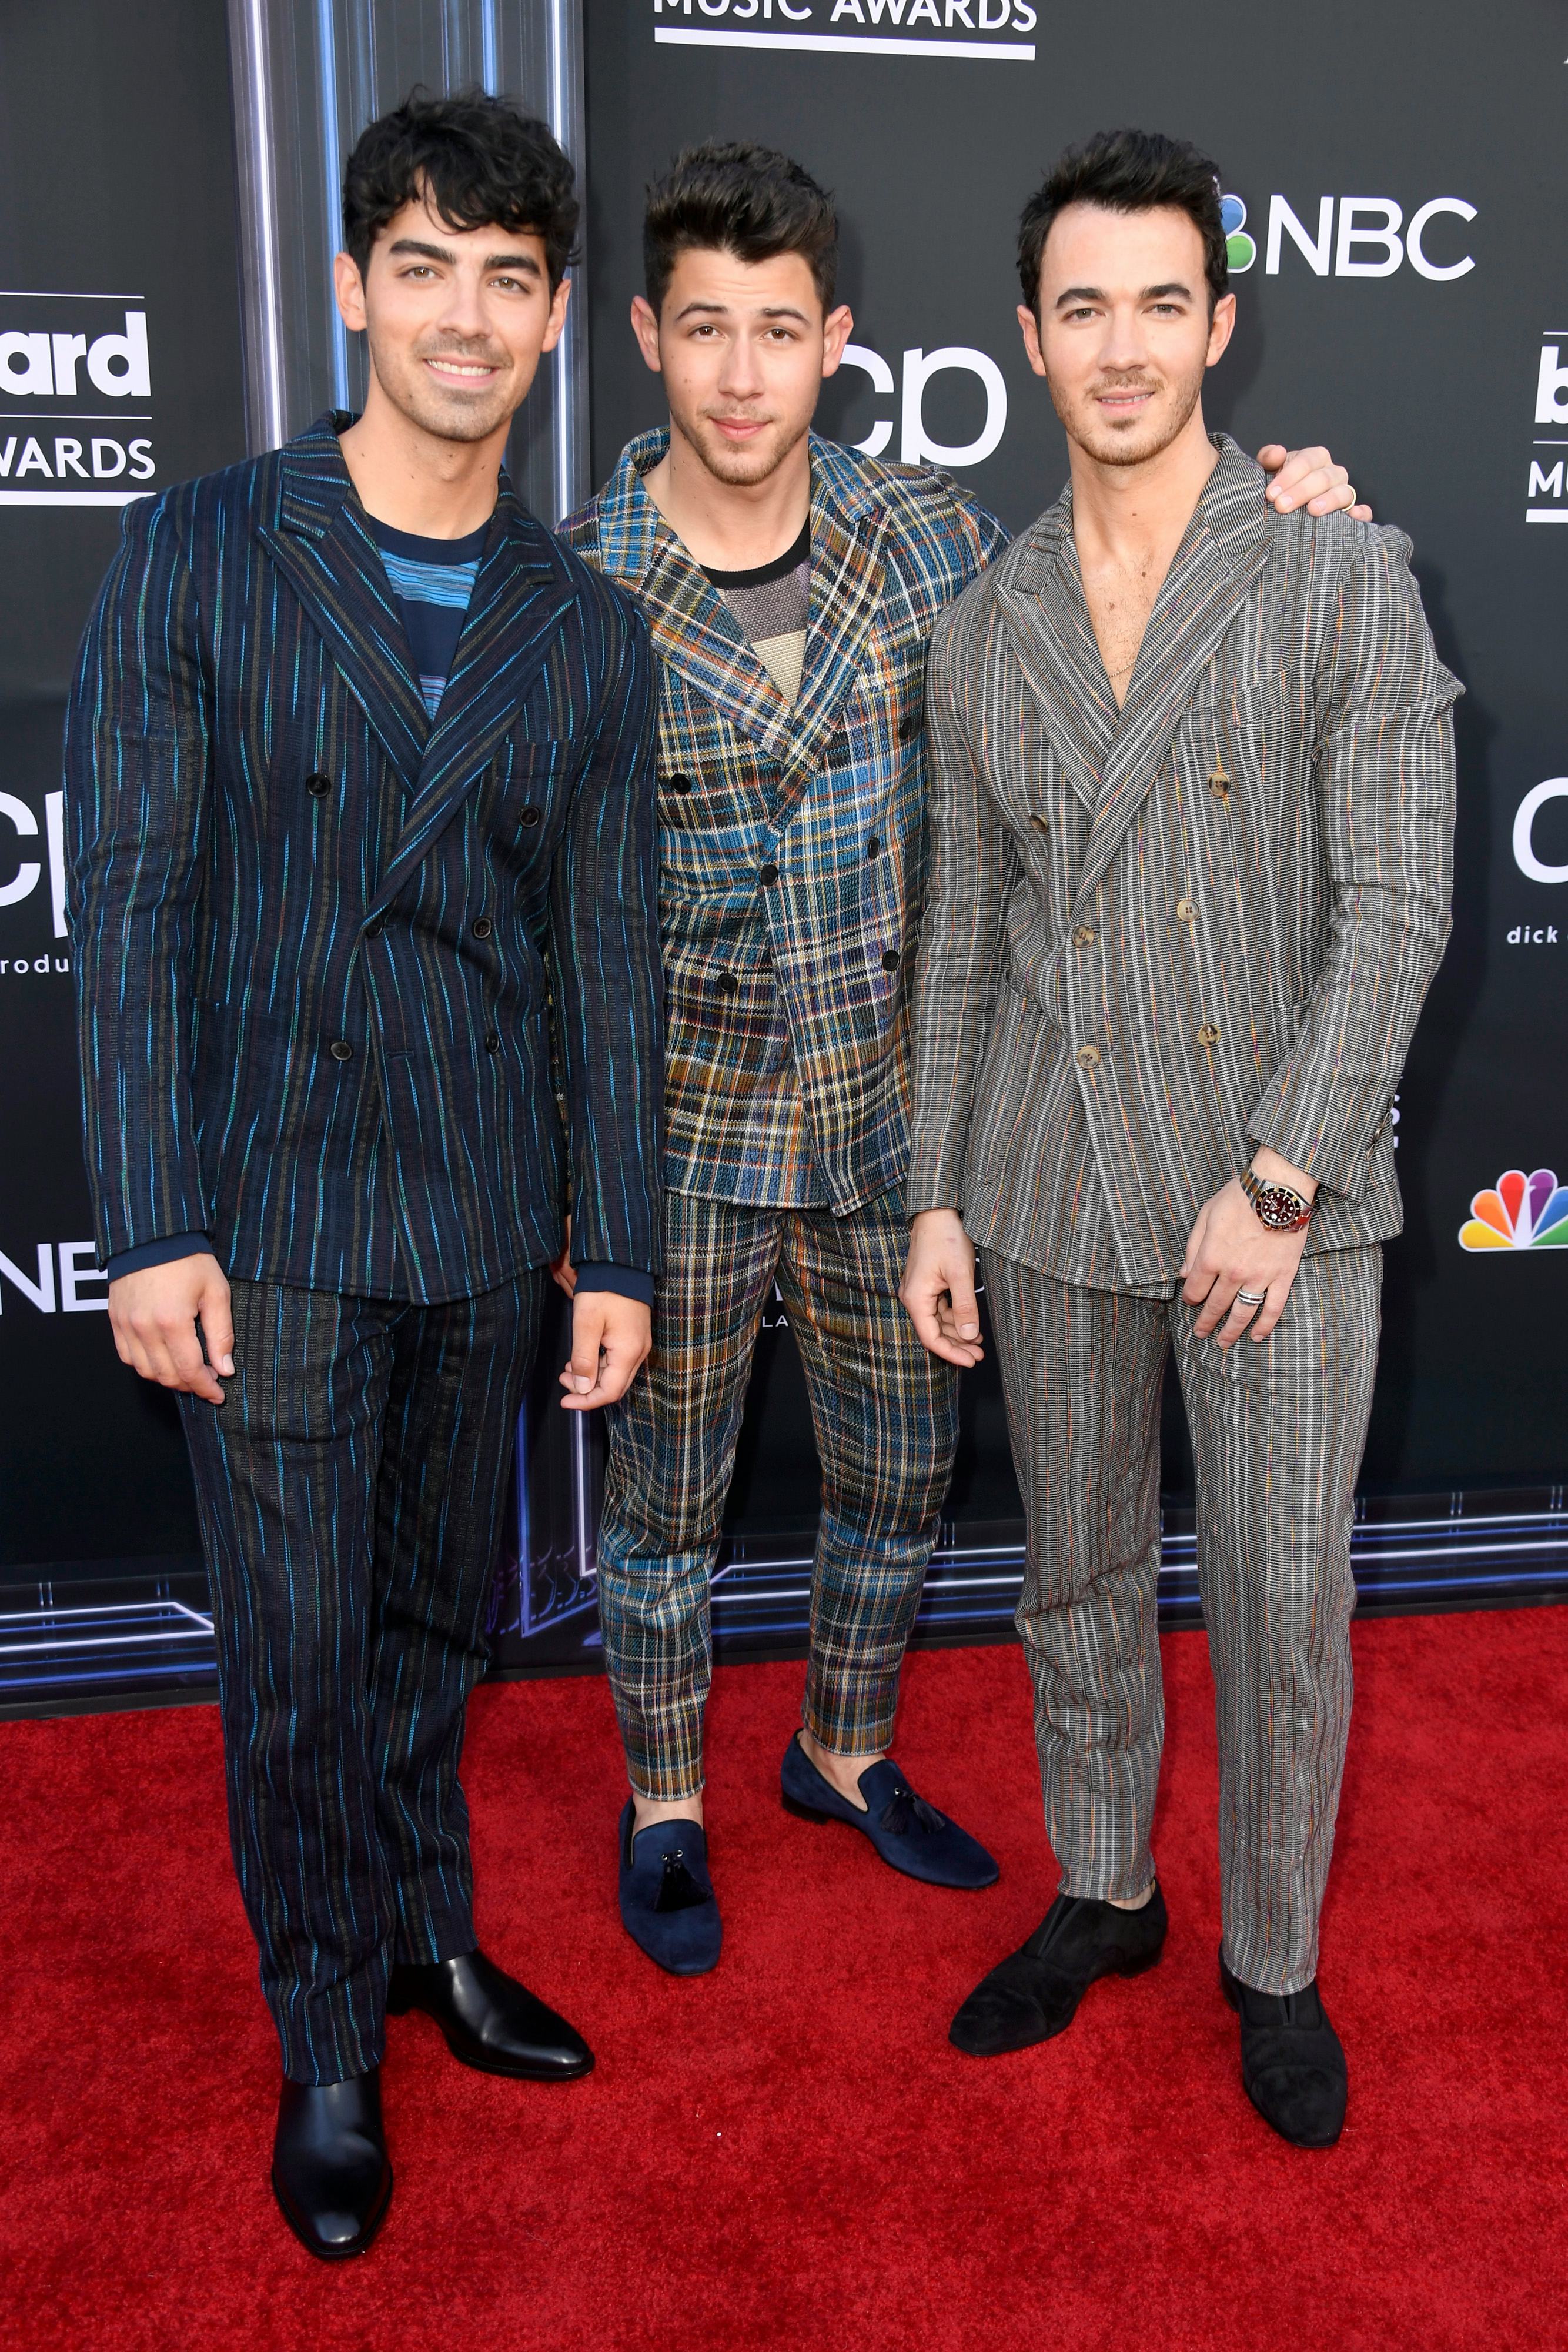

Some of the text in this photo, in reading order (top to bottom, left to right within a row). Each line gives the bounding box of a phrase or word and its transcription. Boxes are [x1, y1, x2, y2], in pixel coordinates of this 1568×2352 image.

[830, 0, 1037, 32] AWARDS
[1266, 195, 1477, 281] NBC
[0, 312, 151, 396] ard
[1528, 461, 1568, 497] M
[1507, 926, 1557, 944] dick
[1, 954, 68, 974] rodu
[763, 1315, 788, 1327] LA
